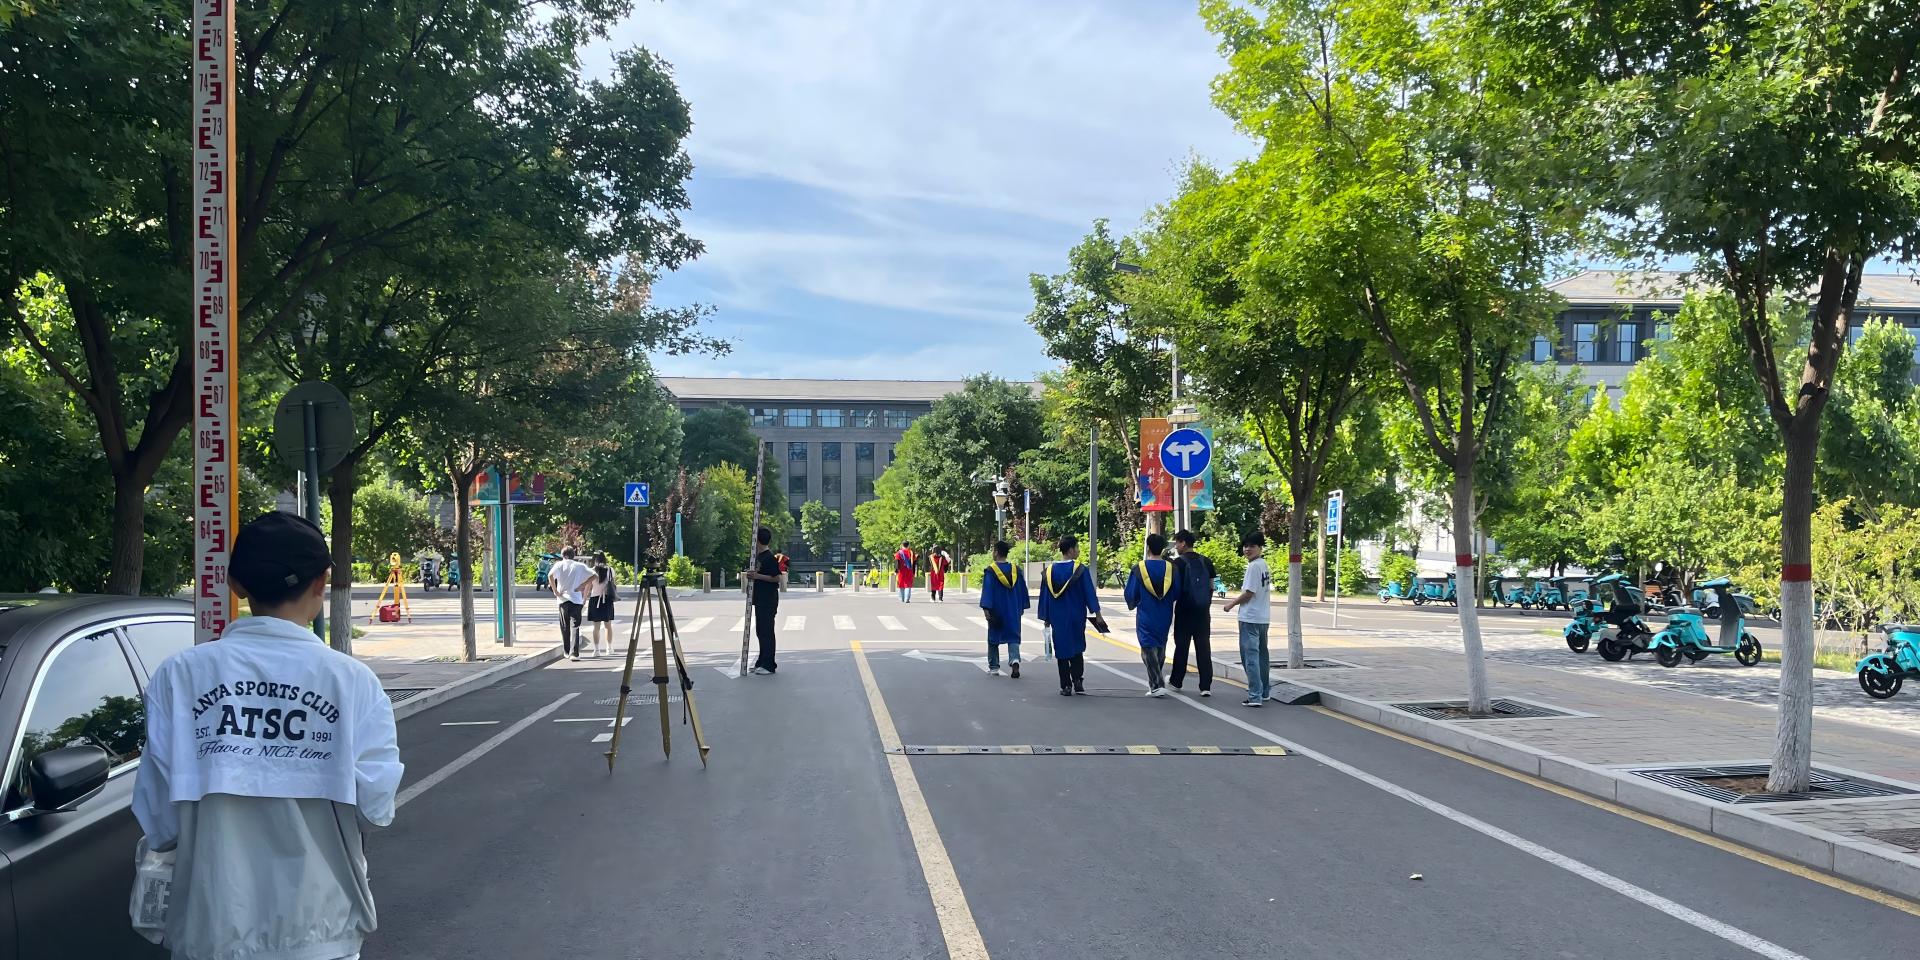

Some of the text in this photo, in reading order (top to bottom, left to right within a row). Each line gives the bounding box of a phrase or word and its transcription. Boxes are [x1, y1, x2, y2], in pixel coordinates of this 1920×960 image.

[212, 29, 222, 48] 75
[199, 73, 208, 92] 74
[212, 117, 222, 136] 73
[199, 162, 209, 180] 72
[213, 206, 222, 225] 71
[199, 251, 209, 269] 70
[213, 295, 223, 314] 69
[200, 340, 210, 359] 68
[213, 385, 224, 404] 67
[200, 430, 210, 448] 66
[214, 474, 224, 493] 65
[201, 520, 210, 539] 64
[215, 565, 225, 584] 63
[201, 610, 211, 629] 62
[192, 681, 340, 724] ANTA SPORTS CLUB
[216, 705, 307, 741] ATSC
[311, 731, 332, 742] 1991
[196, 739, 333, 760] Have a NICE time
